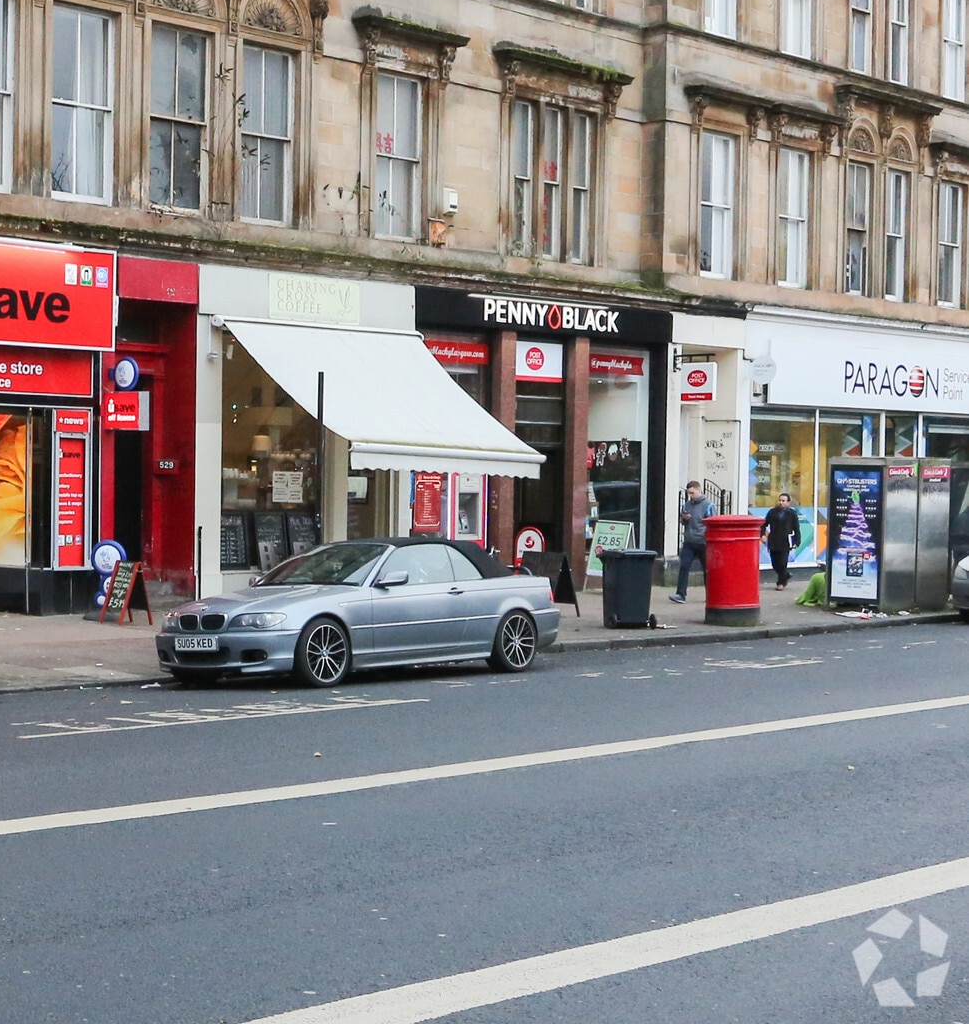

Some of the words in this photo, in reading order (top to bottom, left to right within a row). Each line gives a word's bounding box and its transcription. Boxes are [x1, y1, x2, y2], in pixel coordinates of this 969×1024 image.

[276, 278, 337, 295] CHARING
[277, 289, 316, 303] CROSS
[277, 300, 322, 315] COFFEE
[483, 298, 549, 327] PENNY
[561, 306, 620, 333] BLACK
[10, 360, 44, 375] store
[843, 360, 940, 398] PARAGON
[942, 385, 964, 400] Point
[63, 417, 84, 425] news
[159, 460, 174, 469] 529
[196, 638, 213, 649] KED
